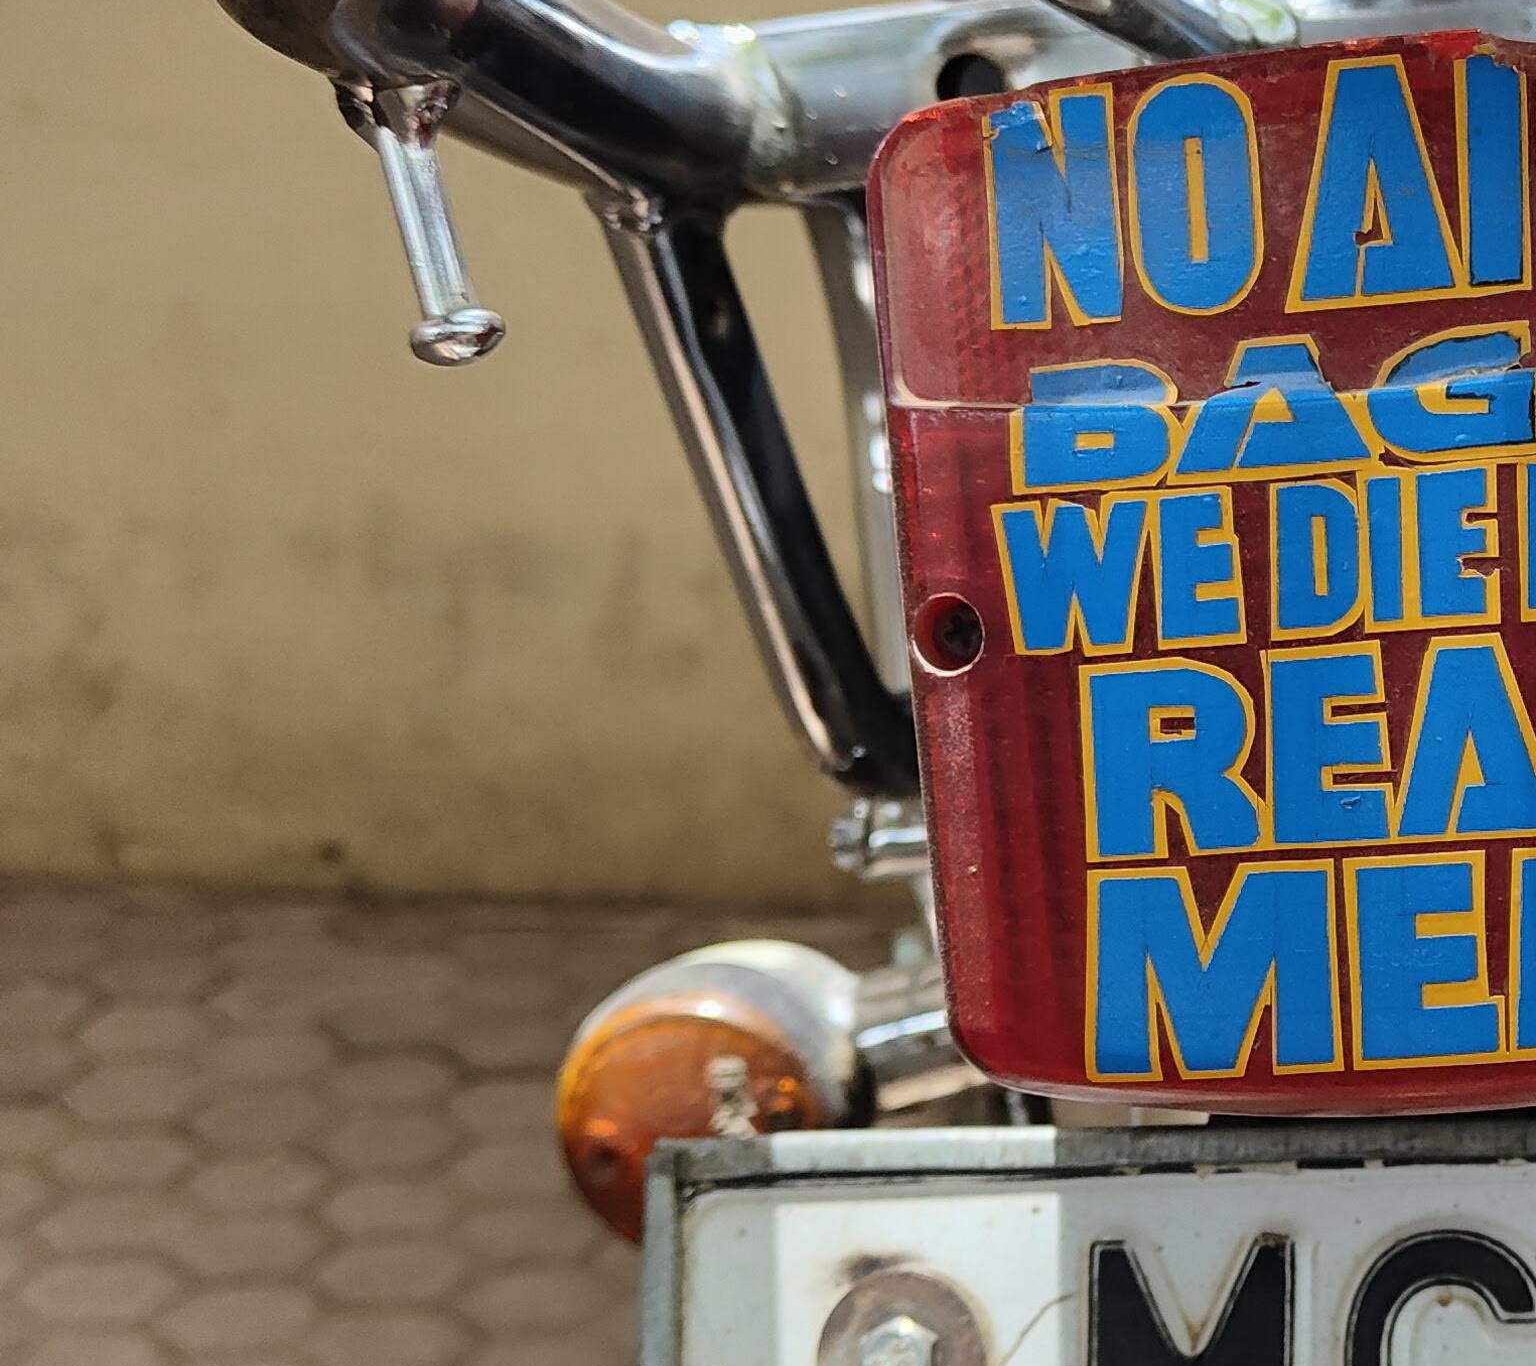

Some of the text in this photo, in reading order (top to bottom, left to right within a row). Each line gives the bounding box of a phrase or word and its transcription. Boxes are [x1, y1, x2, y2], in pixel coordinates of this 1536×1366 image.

[981, 73, 1264, 331] NO
[991, 485, 1247, 657] WE
[1270, 465, 1500, 643] DIE
